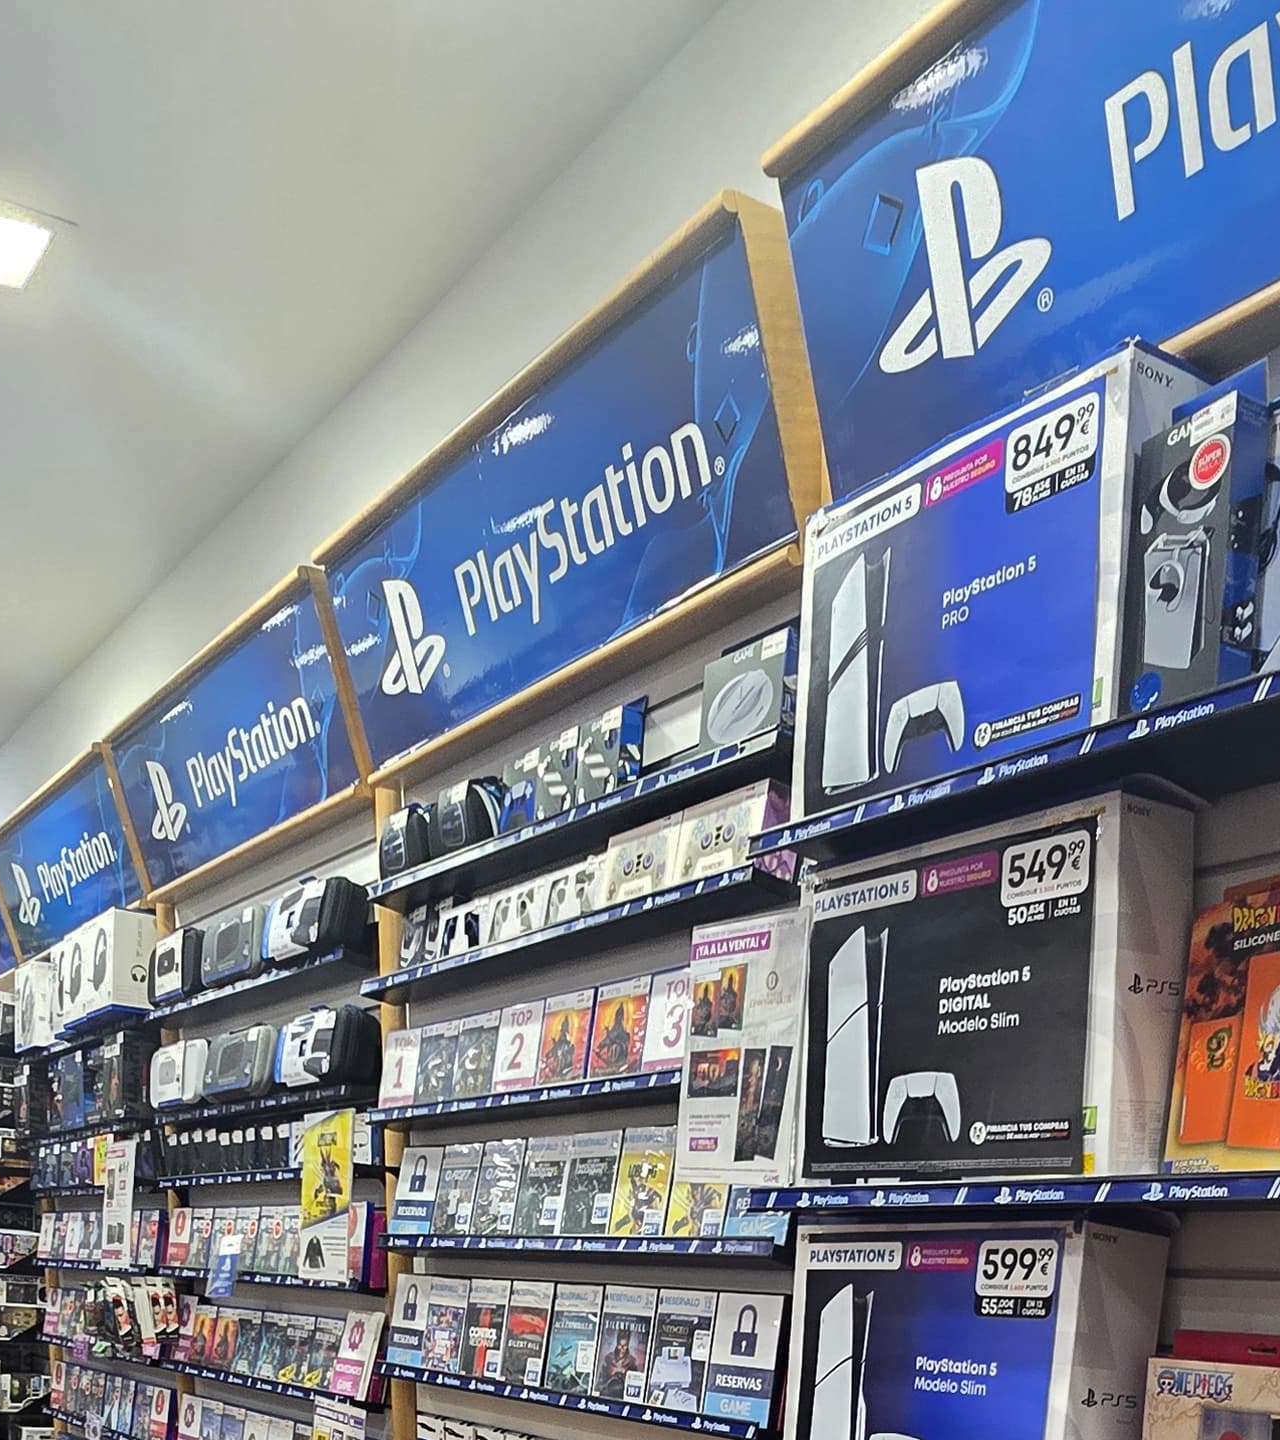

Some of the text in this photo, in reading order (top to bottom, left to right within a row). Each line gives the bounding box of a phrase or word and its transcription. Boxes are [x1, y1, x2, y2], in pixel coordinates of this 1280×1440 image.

[1136, 362, 1173, 388] SONY
[454, 421, 709, 635] PlayStation
[817, 496, 912, 556] PLAYSTATION 5
[943, 555, 1036, 608] PlayStation 5
[942, 605, 969, 628] PRO
[186, 696, 314, 807] PlayStation
[37, 831, 113, 904] PlayStation
[815, 880, 910, 914] PLAYSTATION 5
[1232, 904, 1276, 933] DRAGON
[1233, 930, 1280, 951] SILICONE
[939, 966, 1031, 993] PlayStation 5
[1147, 979, 1180, 997] PS5
[939, 994, 991, 1015] DIGITAL
[511, 1010, 534, 1026] TOP
[938, 1012, 1020, 1035] Modelo Slim
[508, 1034, 524, 1071] 2
[392, 1060, 404, 1089] 1
[810, 1249, 895, 1263] PLAYSTATION 5
[916, 1356, 997, 1376] PlayStation 5
[715, 1374, 762, 1392] RESERVAS
[914, 1377, 986, 1396] Modelo Slim
[1101, 1392, 1137, 1409] PS5
